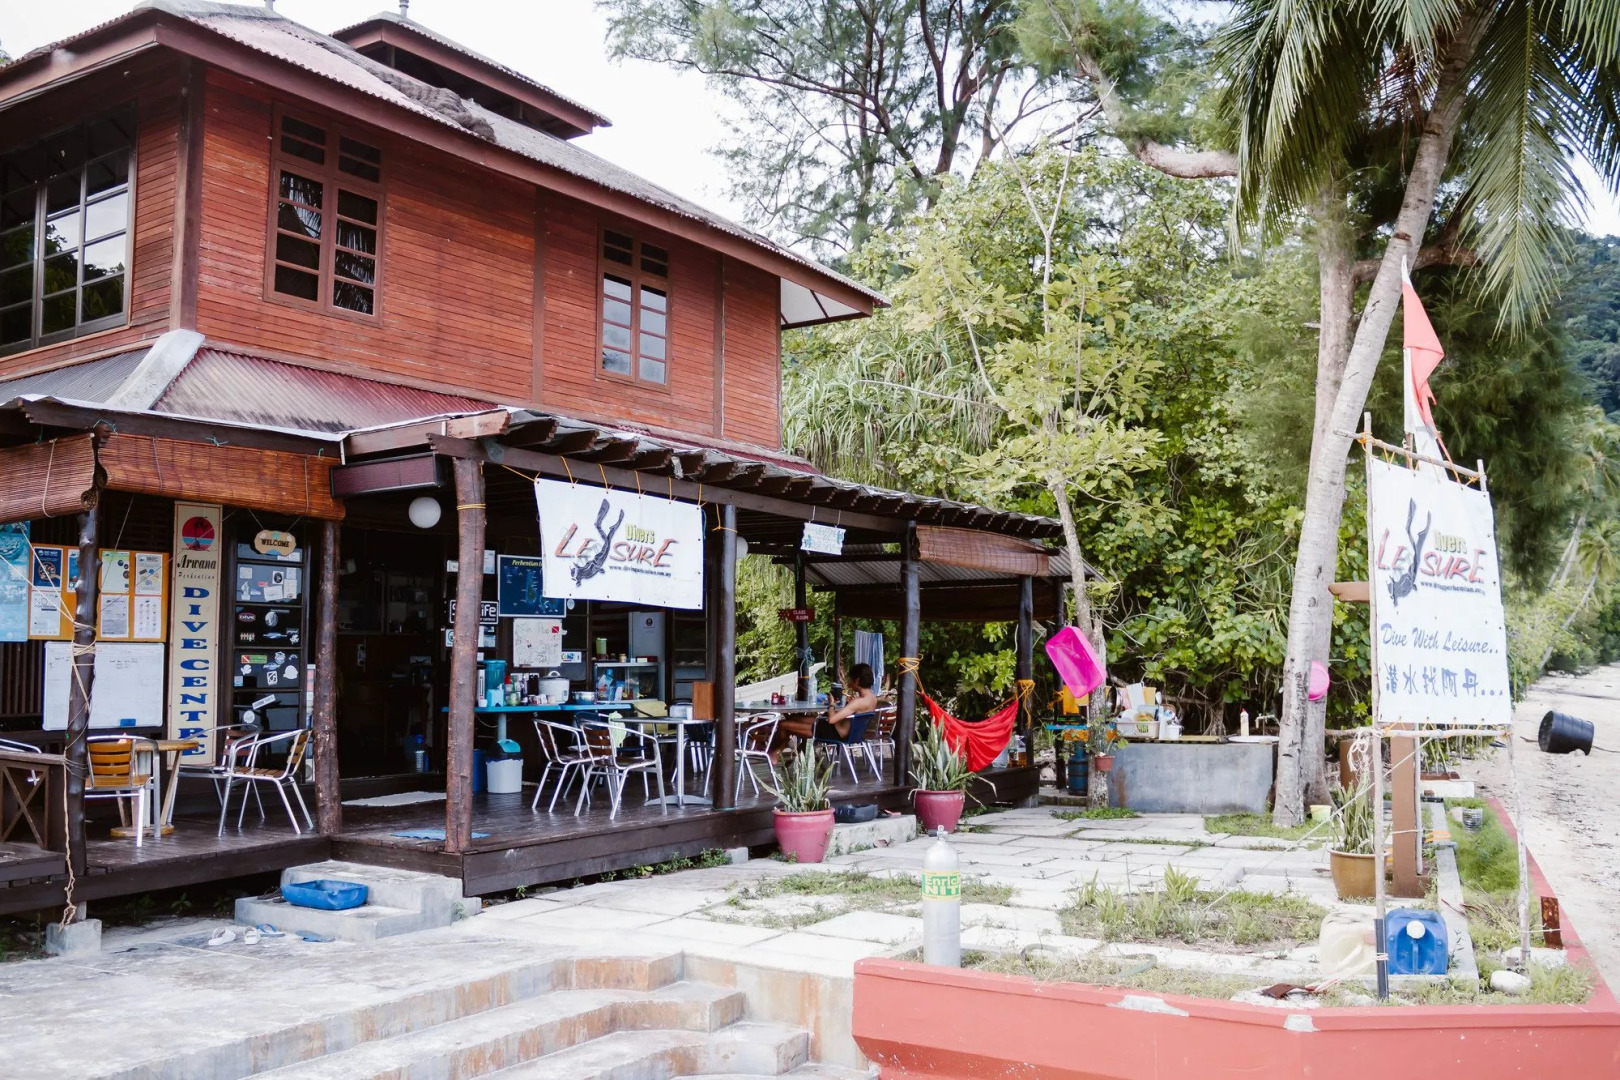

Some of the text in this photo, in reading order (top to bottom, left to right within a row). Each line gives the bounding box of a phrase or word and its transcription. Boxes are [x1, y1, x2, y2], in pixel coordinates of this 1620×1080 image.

[261, 539, 290, 548] WELCOME
[626, 523, 655, 544] Divers
[177, 554, 217, 570] Arwana
[1380, 623, 1408, 646] Dive
[1412, 627, 1440, 649] With
[179, 586, 210, 756] DIVE CENTRE
